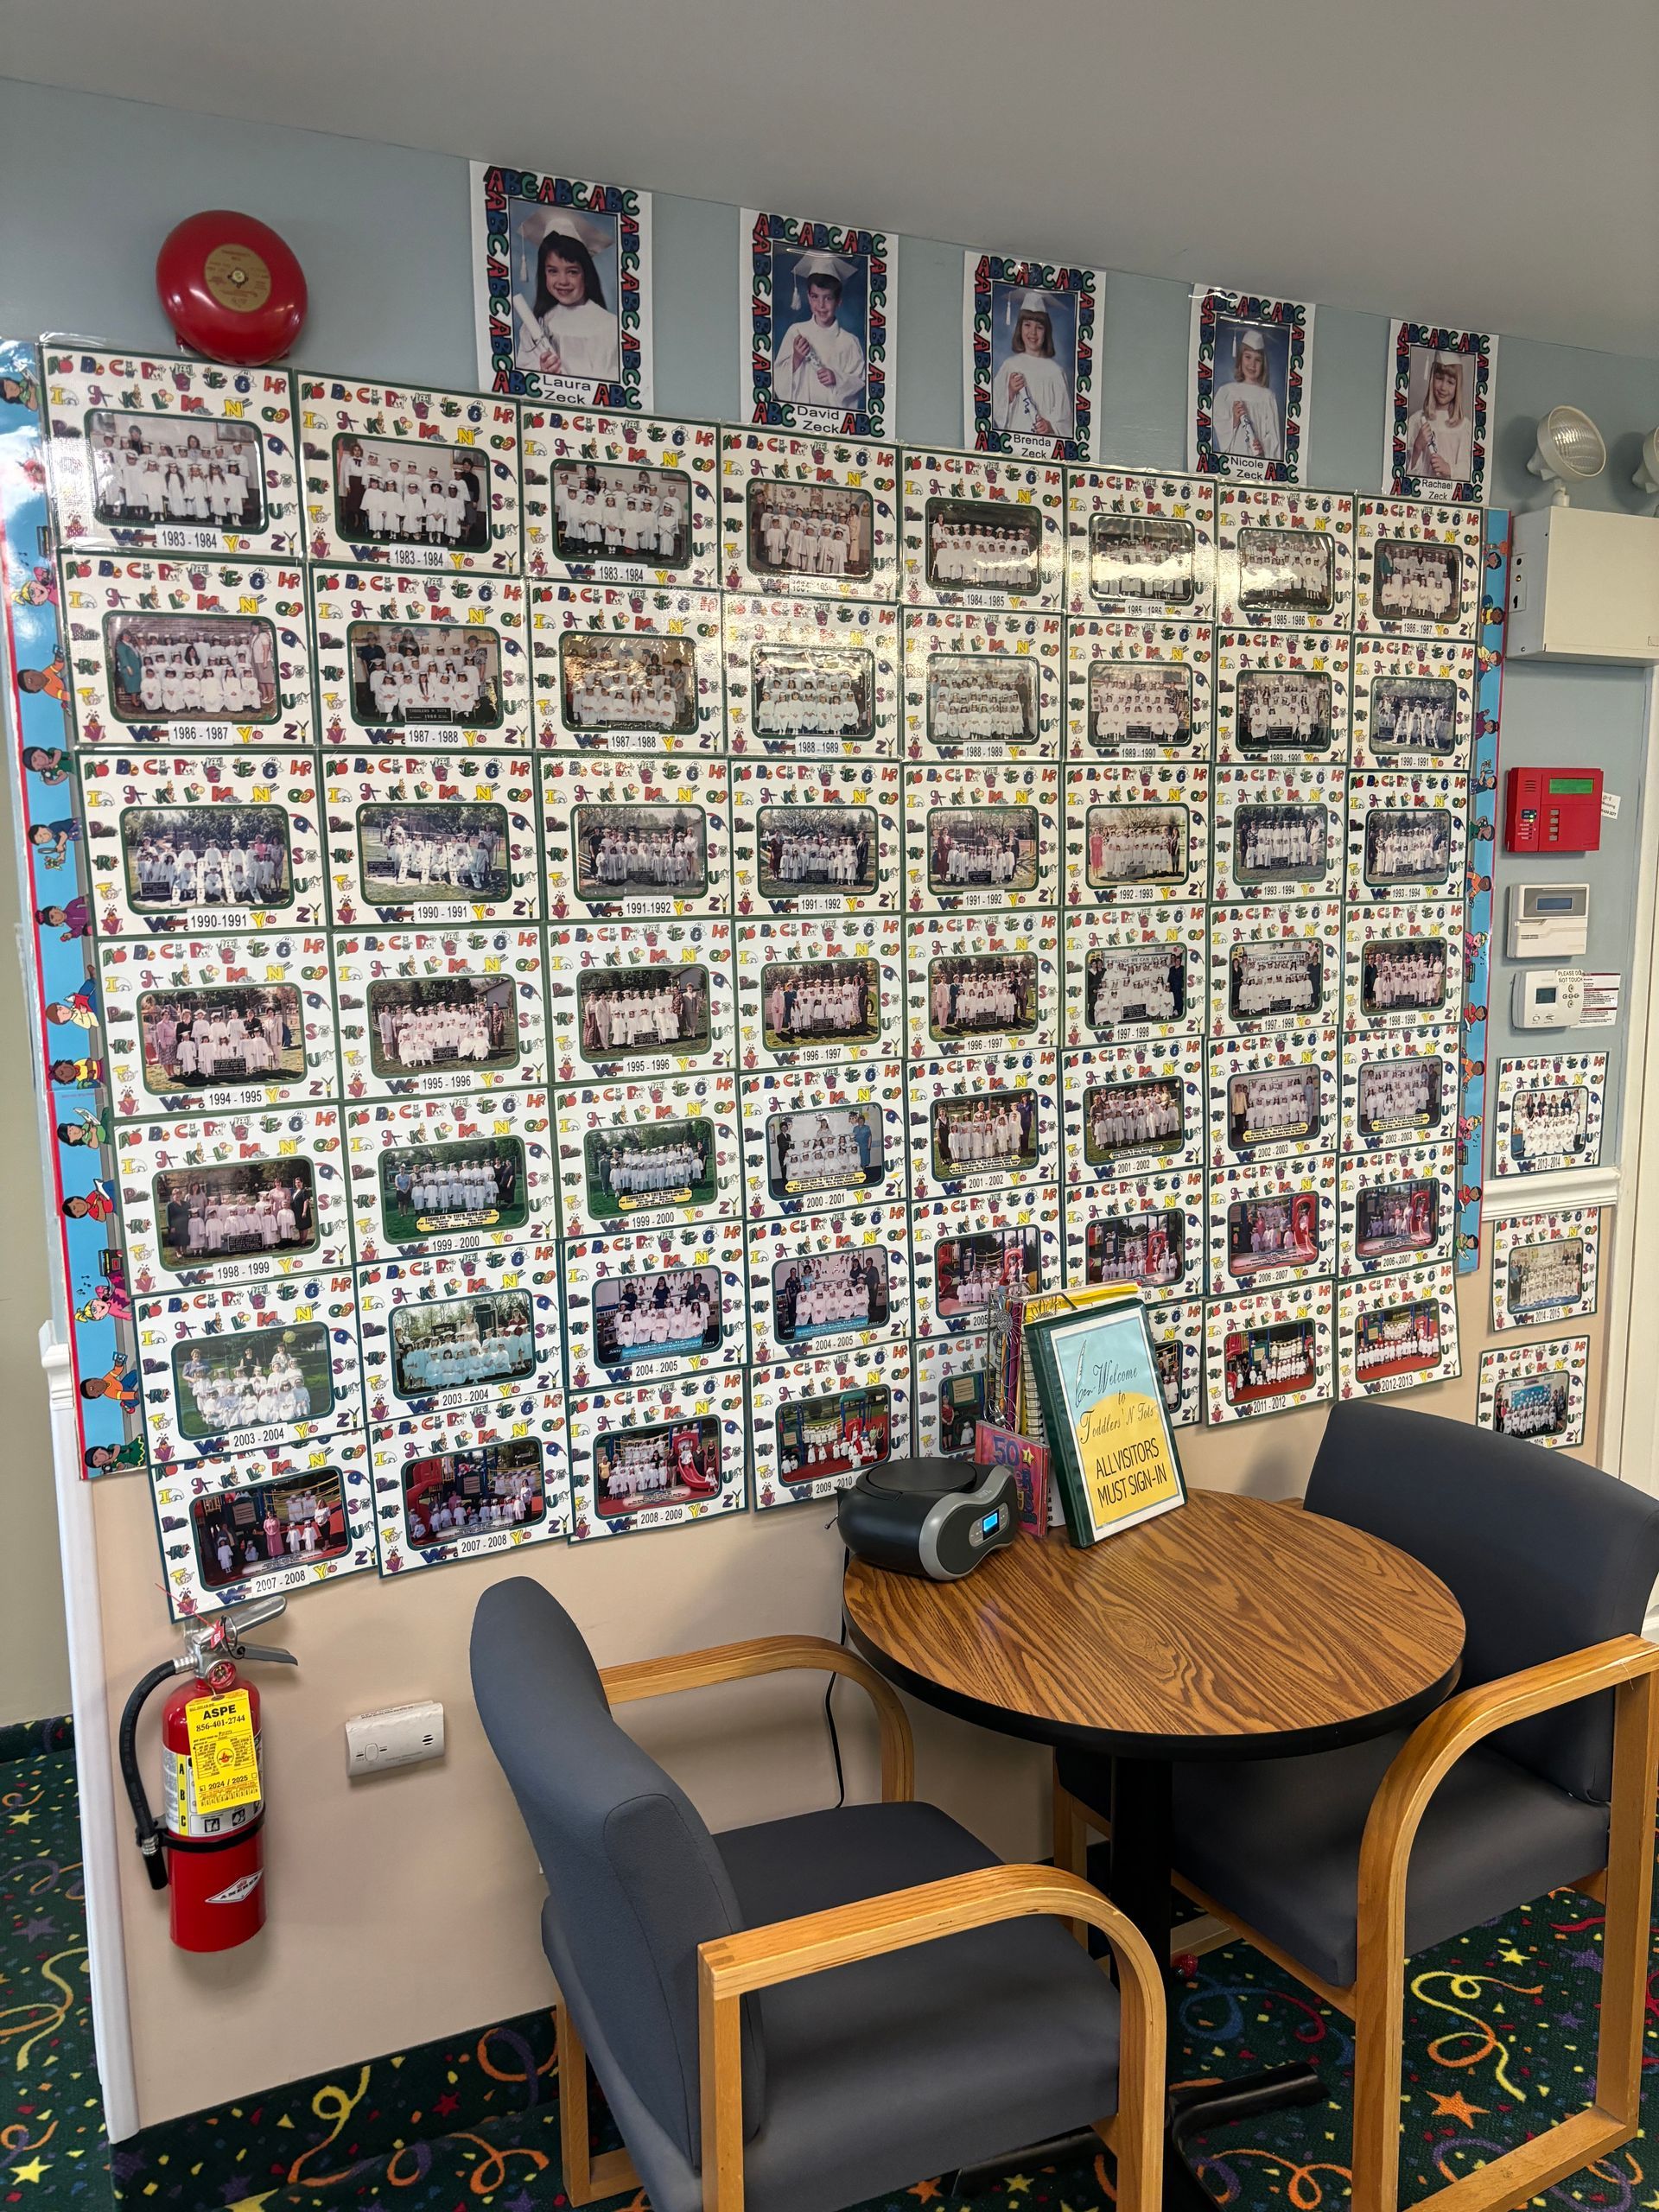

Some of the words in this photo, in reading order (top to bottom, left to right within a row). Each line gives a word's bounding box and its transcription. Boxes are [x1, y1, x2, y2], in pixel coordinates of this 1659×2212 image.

[543, 375, 591, 391] Laura
[544, 390, 585, 404] Zeck
[798, 406, 839, 420] David
[803, 421, 841, 434] Zeck
[1014, 435, 1051, 447] Brenda
[1021, 448, 1046, 459] Zeck
[1230, 456, 1264, 468] Nicole
[1236, 469, 1262, 480] Zeck
[1421, 479, 1452, 490] Rachael
[1428, 491, 1448, 501] Zeck
[162, 531, 186, 547] 1983
[194, 532, 217, 548] 1984
[395, 550, 416, 565] 1983
[423, 551, 443, 567] 1984
[600, 566, 618, 581] 1983
[626, 569, 643, 582] 1984
[967, 594, 982, 606] 1984
[989, 595, 1004, 607] 1985
[1274, 614, 1287, 625] 1985
[1293, 615, 1305, 626] 1986
[174, 727, 196, 740] 1986
[206, 727, 228, 740] 1987
[409, 730, 429, 742] 1987
[438, 730, 458, 743] 1988
[798, 741, 816, 753] 1988
[823, 742, 839, 753] 1989
[1122, 748, 1136, 758] 1989
[1141, 748, 1156, 758] 1990
[1120, 889, 1134, 899] 1992
[1139, 888, 1154, 899] 1993
[1264, 886, 1277, 895] 1993
[1282, 885, 1295, 895] 1994
[802, 899, 817, 910] 1991
[824, 898, 841, 909] 1992
[966, 895, 980, 906] 1991
[987, 893, 1001, 905] 1992
[418, 906, 439, 918] 1990
[448, 906, 467, 918] 1991
[1265, 1019, 1277, 1030] 1997
[1282, 1018, 1294, 1028] 1998
[1117, 1028, 1131, 1039] 1997
[1136, 1027, 1149, 1038] 1998
[968, 1039, 982, 1051] 1996
[988, 1038, 1002, 1048] 1997
[803, 1050, 819, 1061] 1996
[825, 1048, 841, 1059] 1997
[627, 1060, 645, 1072] 1995
[652, 1058, 670, 1071] 1996
[423, 1077, 442, 1090] 1995
[451, 1075, 471, 1087] 1996
[209, 1092, 231, 1105] 1994
[240, 1090, 262, 1103] 1995
[969, 1178, 982, 1189] 2001
[989, 1174, 1003, 1185] 2002
[807, 1196, 823, 1208] 2000
[829, 1193, 844, 1205] 2001
[632, 1215, 650, 1228] 1999
[657, 1211, 674, 1224] 2000
[433, 1239, 452, 1251] 1999
[460, 1236, 480, 1249] 2000
[218, 1265, 239, 1279] 1998
[248, 1262, 270, 1275] 1999
[816, 1339, 831, 1351] 2004
[837, 1335, 853, 1347] 2005
[636, 1363, 653, 1376] 2004
[660, 1360, 677, 1373] 2005
[1092, 1360, 1138, 1395] Welcome
[442, 1393, 462, 1406] 2003
[469, 1389, 488, 1402] 2004
[1118, 1389, 1126, 1405] to
[1254, 1400, 1266, 1414] 2011
[1272, 1395, 1286, 1409] 2012
[1137, 1403, 1154, 1421] Tots
[233, 1433, 255, 1447] 2003
[263, 1427, 284, 1442] 2004
[993, 1435, 1019, 1465] 50
[1096, 1454, 1116, 1479] ALL
[1113, 1438, 1159, 1471] VISITORS
[817, 1482, 831, 1493] 2009
[1097, 1478, 1127, 1508] MUST
[1128, 1463, 1167, 1495] SIGN-IN
[641, 1512, 658, 1524] 2008
[665, 1509, 683, 1521] 2009
[461, 1540, 480, 1553] 2007
[488, 1535, 507, 1548] 2008
[256, 1577, 276, 1592] 2007
[284, 1570, 306, 1585] 2008
[203, 1704, 236, 1720] ASPE
[196, 1714, 245, 1732] 856-401-2744
[179, 1764, 185, 1775] A
[208, 1780, 225, 1790] 2024
[232, 1775, 248, 1784] 2025
[180, 1789, 186, 1801] B
[181, 1815, 187, 1827] C
